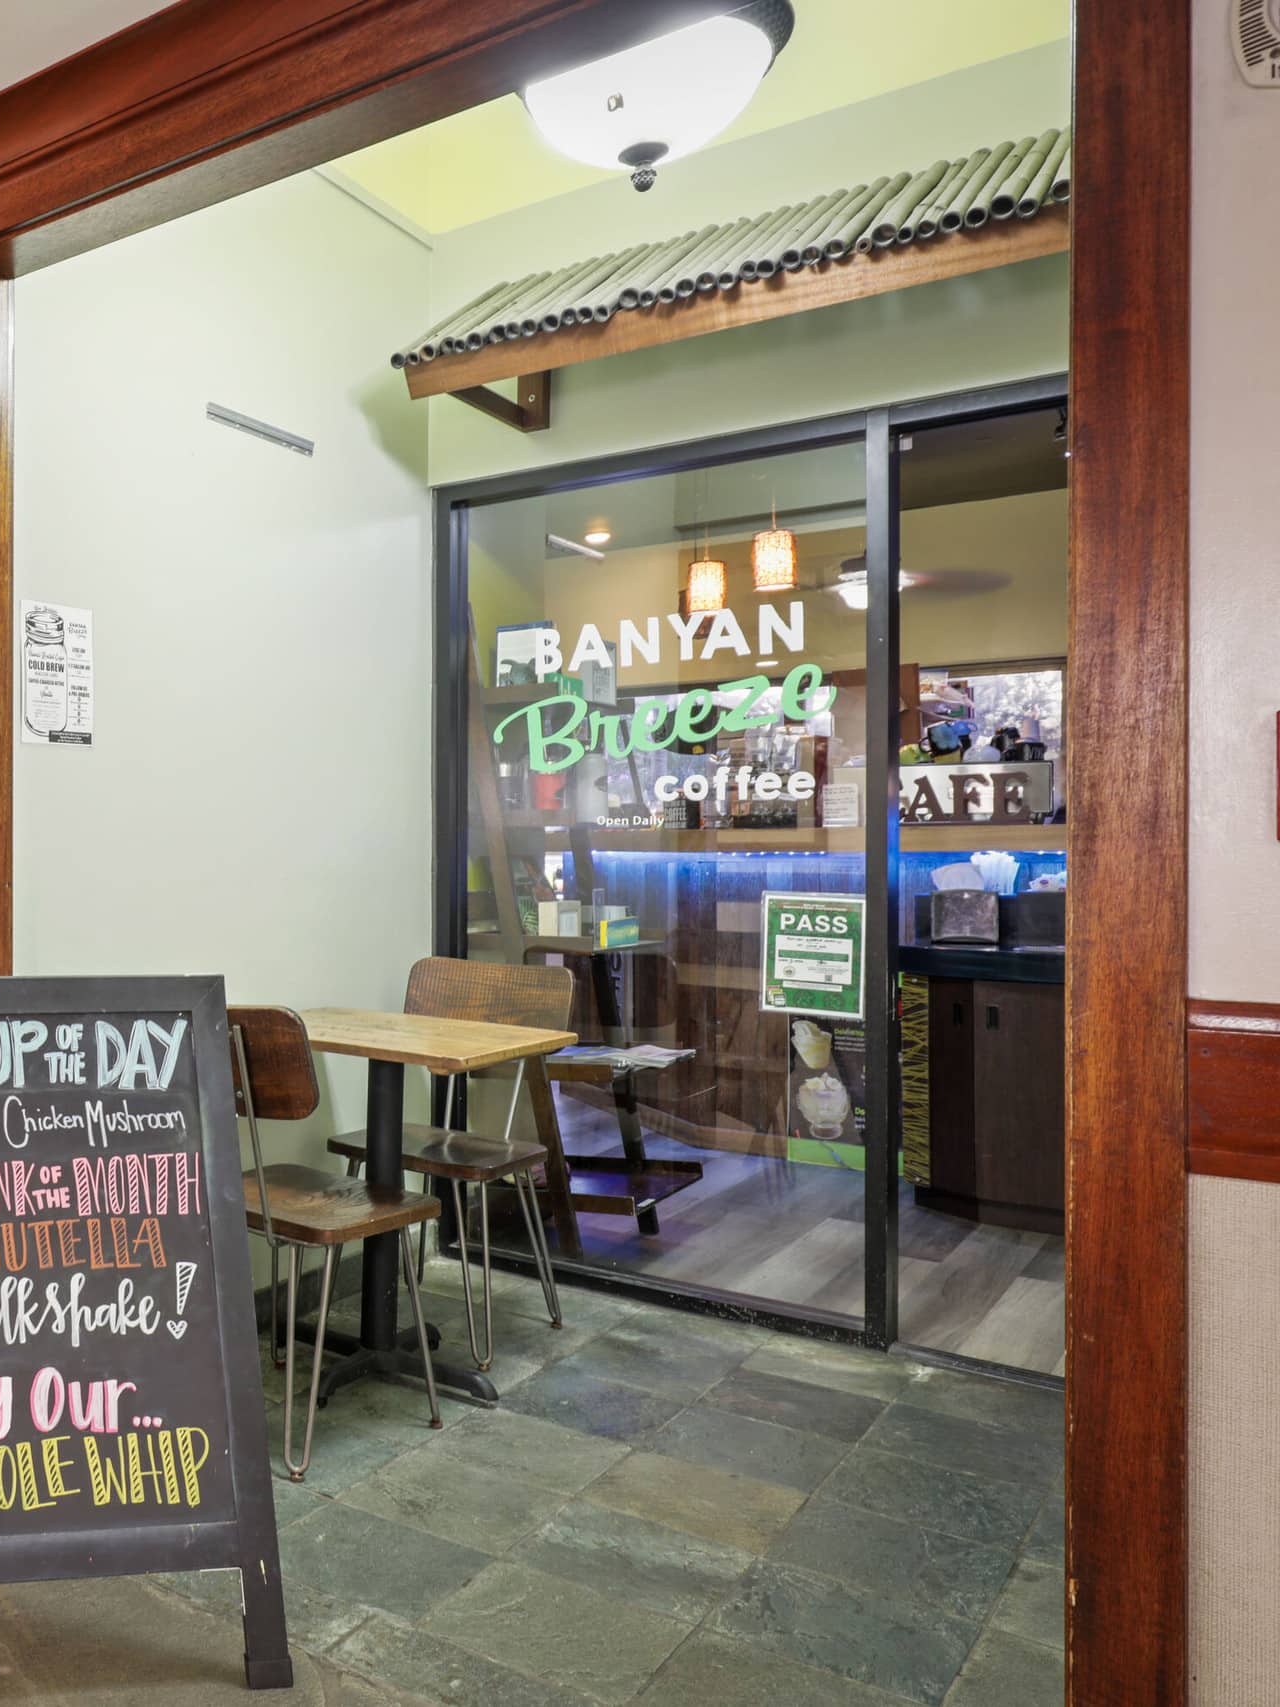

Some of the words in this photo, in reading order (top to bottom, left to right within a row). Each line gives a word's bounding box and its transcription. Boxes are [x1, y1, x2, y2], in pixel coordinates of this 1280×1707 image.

[535, 601, 805, 678] BANYAN
[28, 659, 45, 671] COLD
[46, 661, 65, 673] BREW
[493, 663, 838, 774] Breeze
[654, 766, 816, 803] coffee
[899, 771, 1032, 823] AFE
[597, 815, 629, 828] Open
[633, 815, 665, 828] Daily
[780, 913, 849, 934] PASS
[56, 1023, 84, 1051] OF
[95, 1019, 188, 1090] DAY
[43, 1050, 86, 1085] THE
[3, 1095, 84, 1149] Chicken
[84, 1099, 186, 1148] Mushroom
[40, 1164, 62, 1184] OF
[73, 1152, 200, 1216] MONTH
[31, 1188, 70, 1209] THE
[85, 1427, 209, 1508] WHIP
